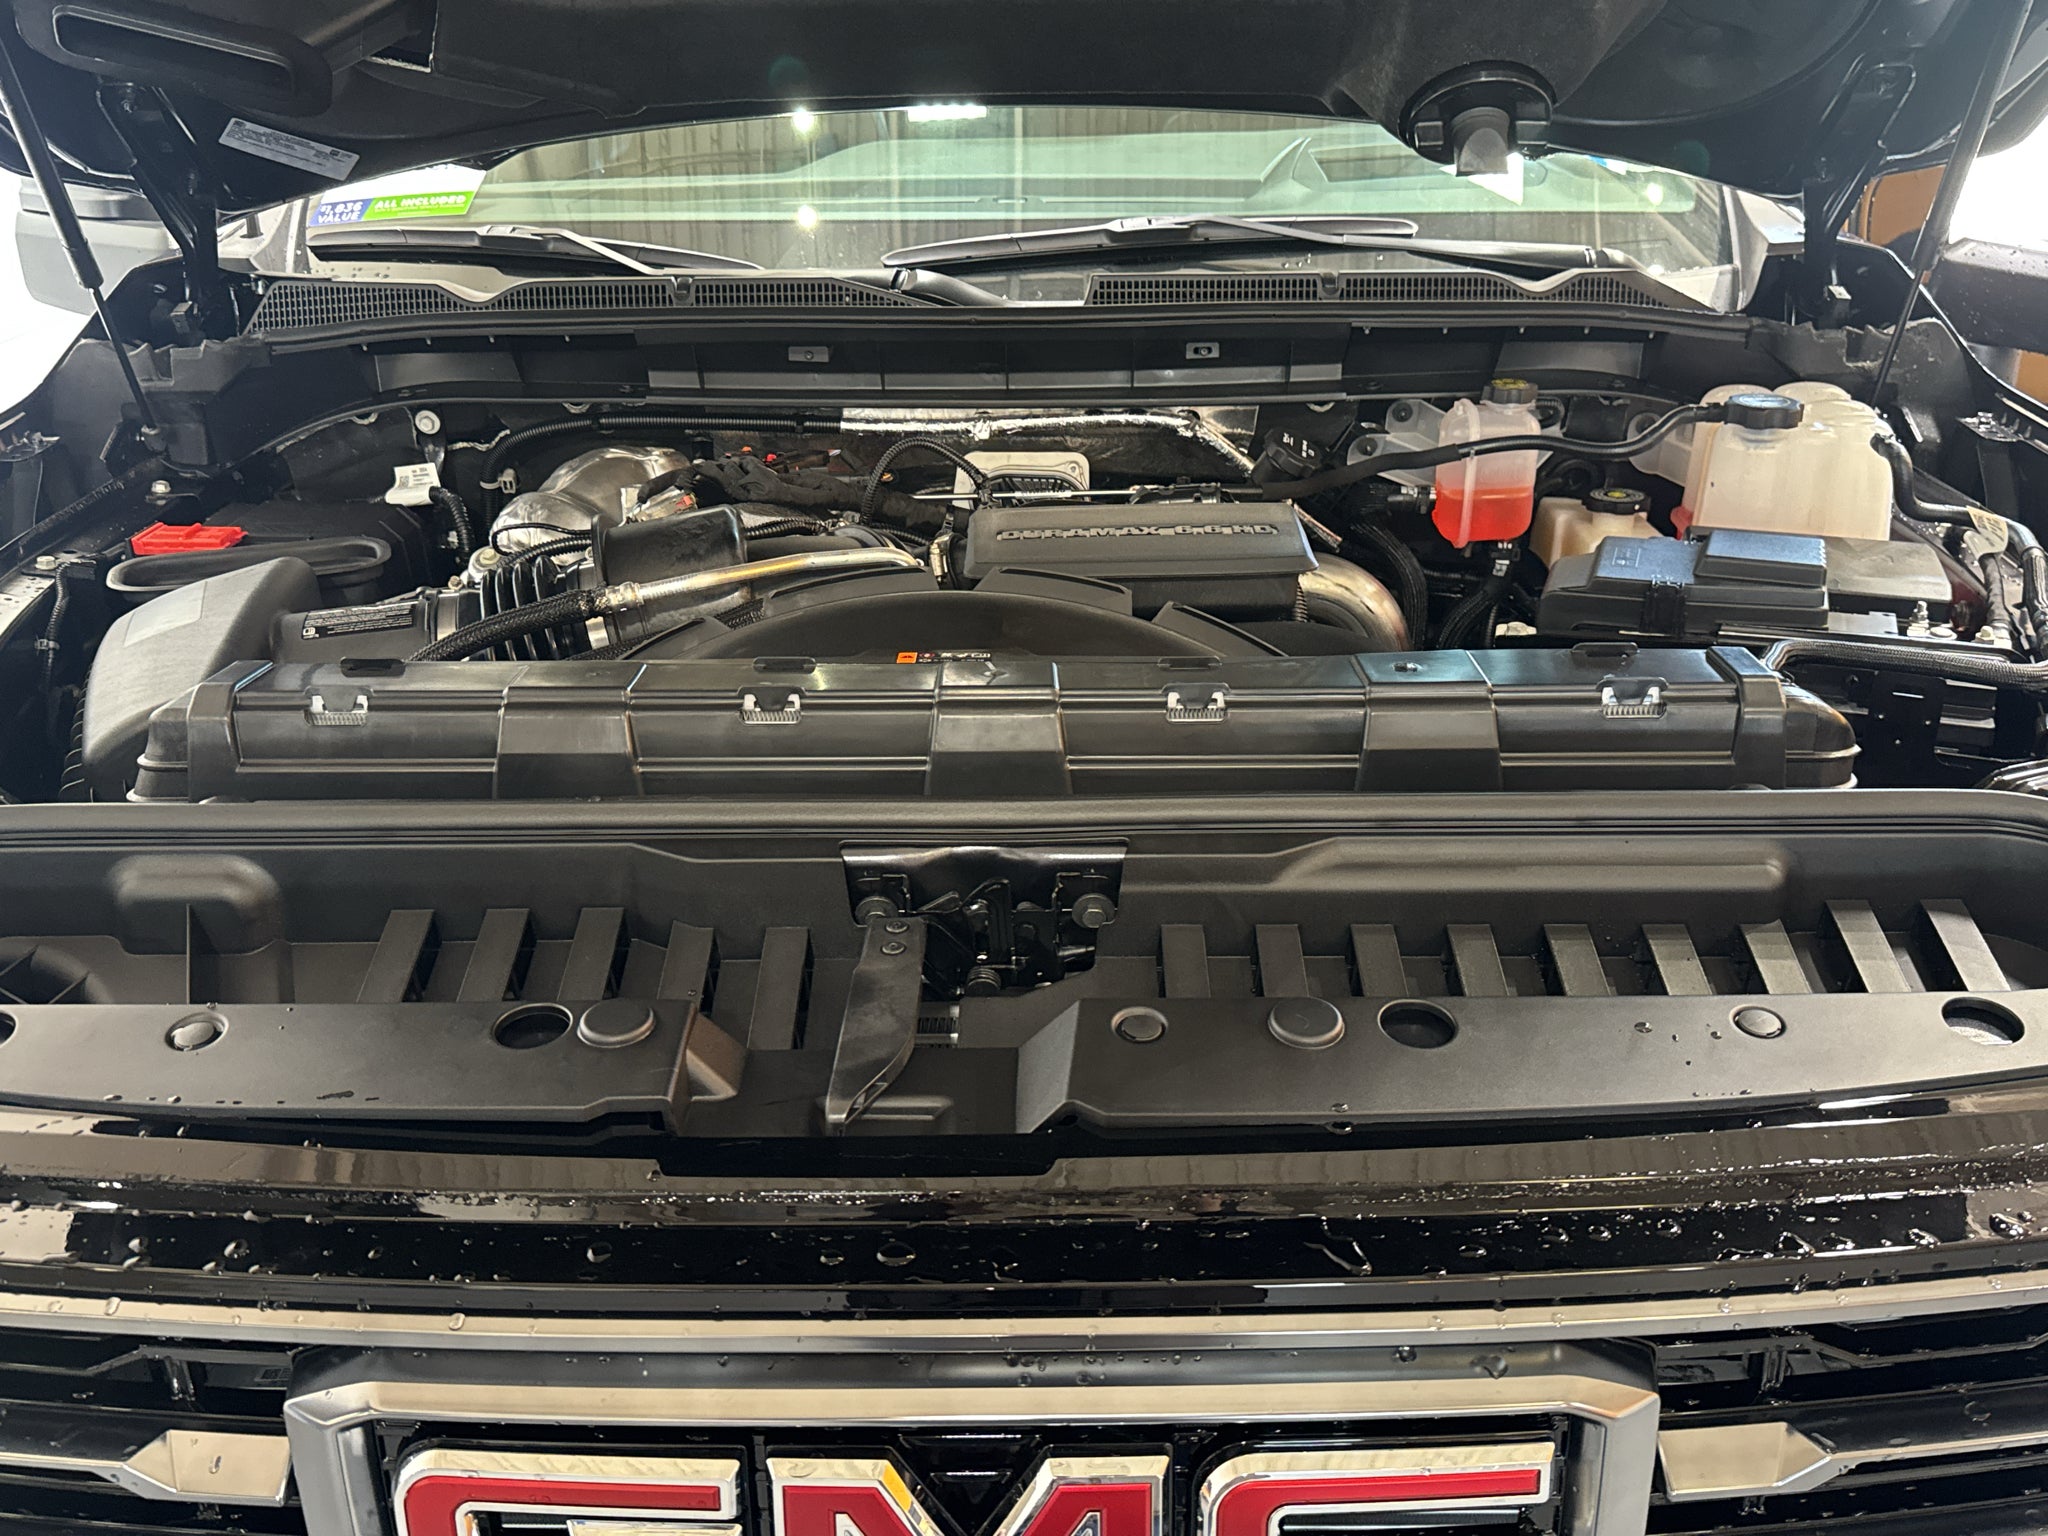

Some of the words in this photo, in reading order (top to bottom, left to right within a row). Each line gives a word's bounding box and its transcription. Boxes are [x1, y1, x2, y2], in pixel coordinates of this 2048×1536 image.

[374, 199, 397, 210] ALL
[400, 194, 466, 207] INCLUDED
[318, 211, 361, 224] VALUE
[1000, 525, 1160, 540] DURAMAX
